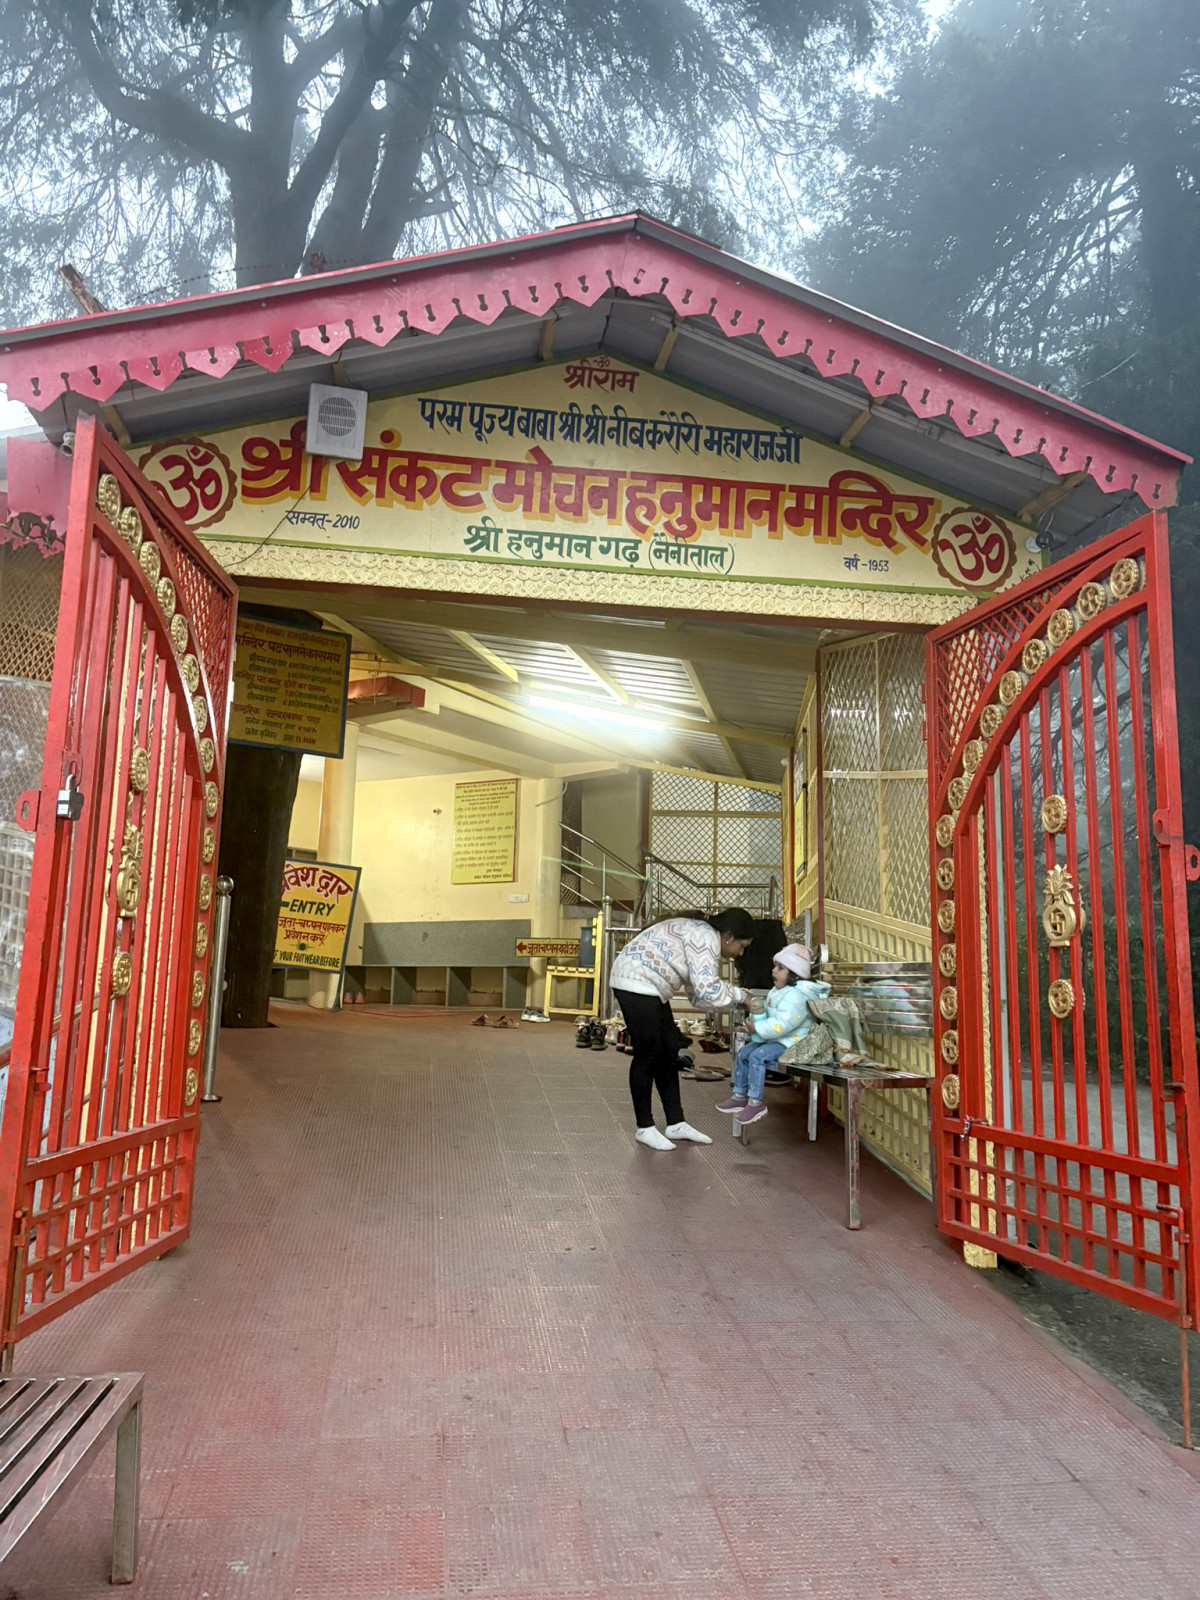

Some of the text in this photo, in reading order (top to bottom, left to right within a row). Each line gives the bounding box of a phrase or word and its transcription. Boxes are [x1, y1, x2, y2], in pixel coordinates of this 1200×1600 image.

[417, 397, 467, 435] परम
[468, 402, 519, 444] पूज्य
[517, 407, 558, 443] बाबा
[558, 402, 584, 444] श्री
[582, 404, 608, 446] श्री
[241, 420, 325, 503] श्री
[625, 470, 787, 540] हनुमान
[784, 470, 938, 553] मन्दिर
[463, 515, 735, 575] श्री हनुमान गढ़ (नैनीताल)
[289, 899, 336, 916] ENTRY
[317, 869, 353, 904] द्वार
[279, 950, 293, 961] YOUR
[293, 952, 320, 965] FOOTWEAR
[320, 955, 341, 968] BEFORE
